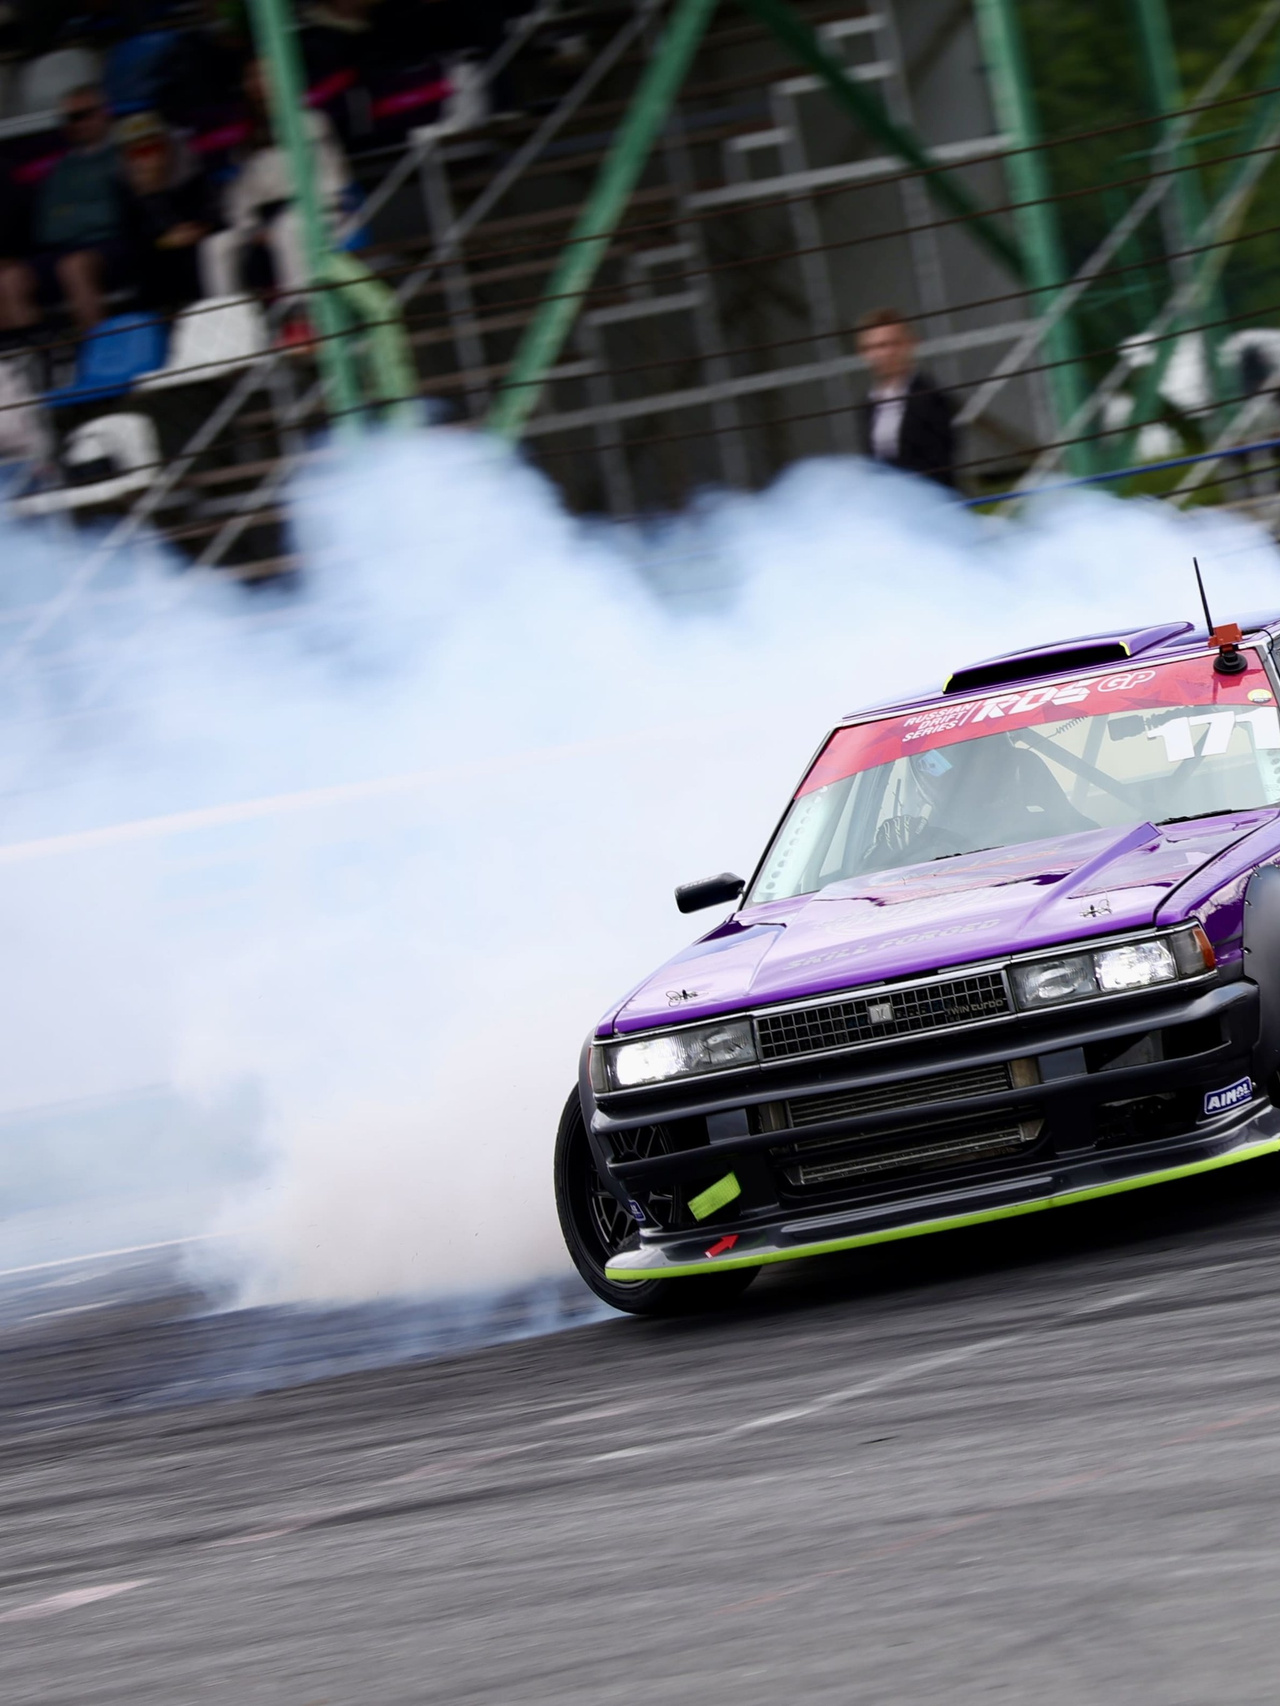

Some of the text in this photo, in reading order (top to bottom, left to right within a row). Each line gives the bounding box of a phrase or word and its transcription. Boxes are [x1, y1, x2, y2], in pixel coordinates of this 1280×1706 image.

[971, 670, 1156, 723] RDS GP
[903, 702, 976, 727] RUSSIAN
[918, 711, 968, 730] DRIFT
[902, 720, 958, 742] SERIES
